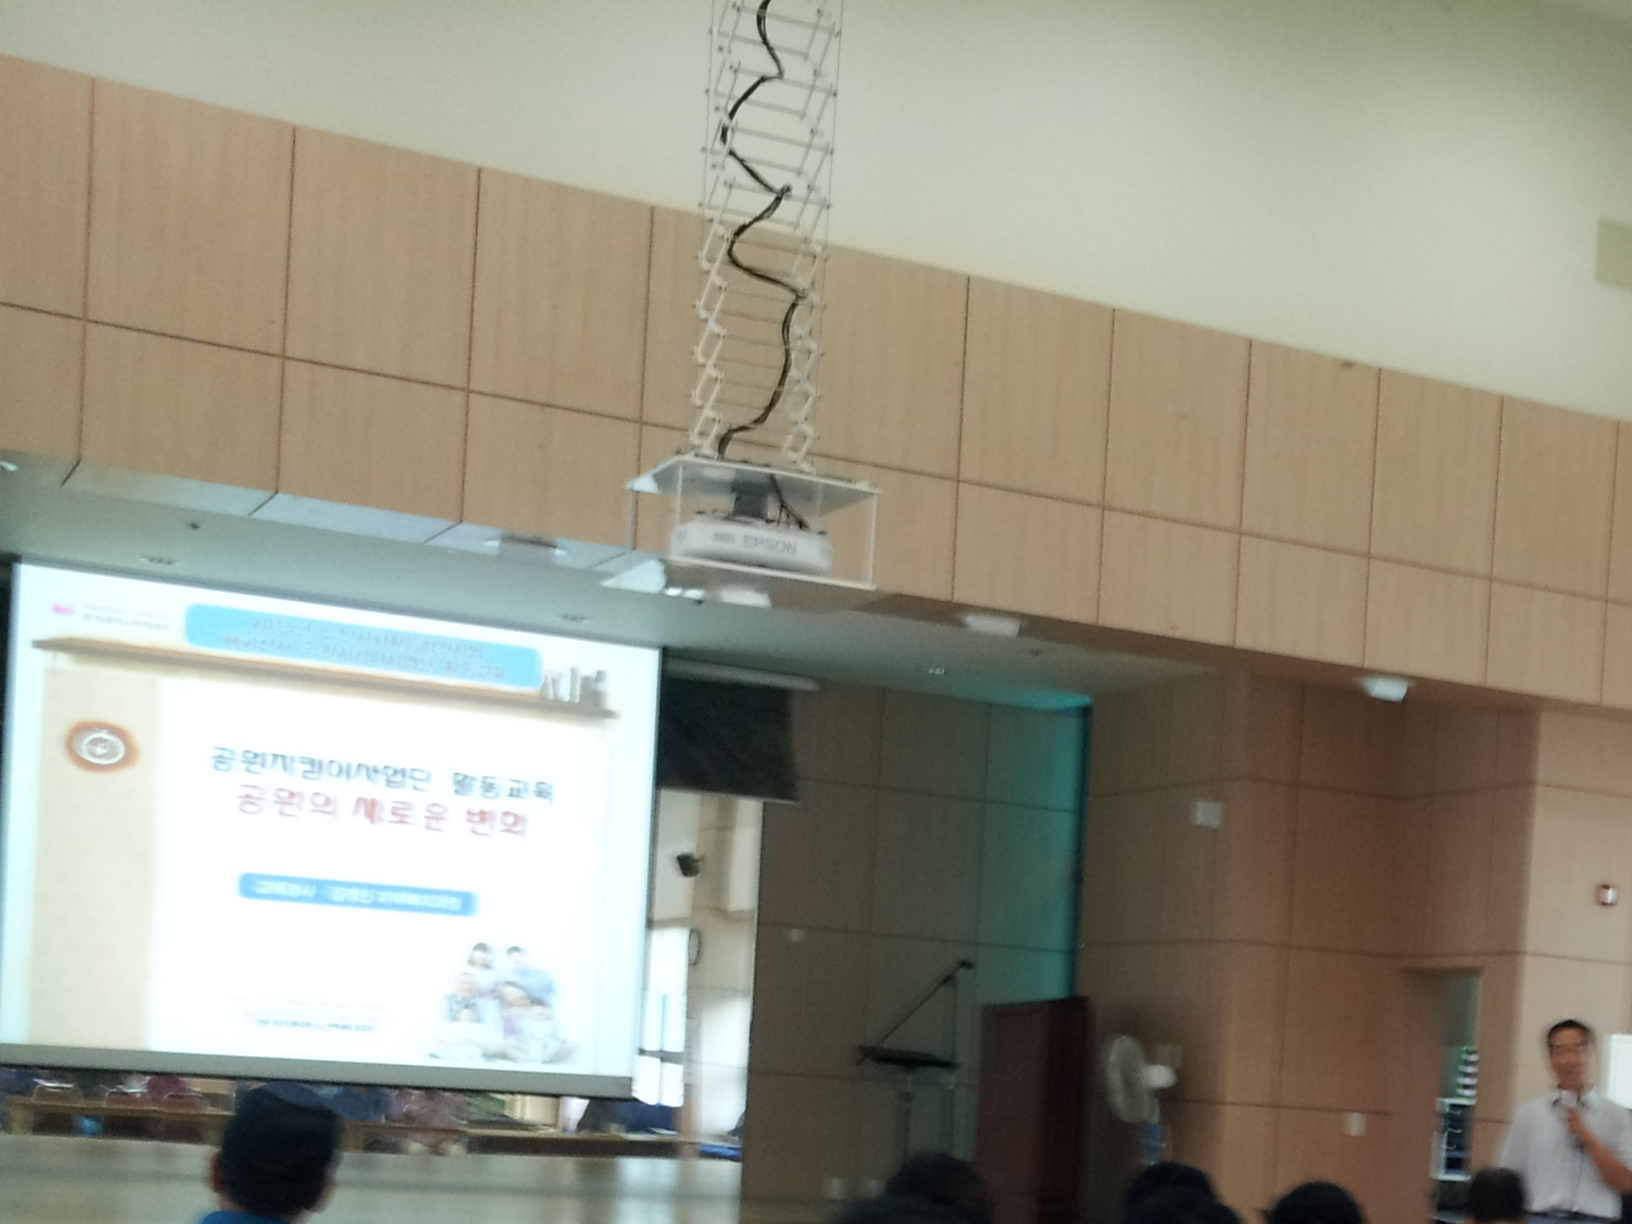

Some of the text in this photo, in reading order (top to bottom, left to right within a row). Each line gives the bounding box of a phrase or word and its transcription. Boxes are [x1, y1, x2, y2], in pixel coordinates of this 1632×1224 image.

[742, 533, 798, 555] EPSON
[238, 784, 527, 837] 공원의 새로운 변화
